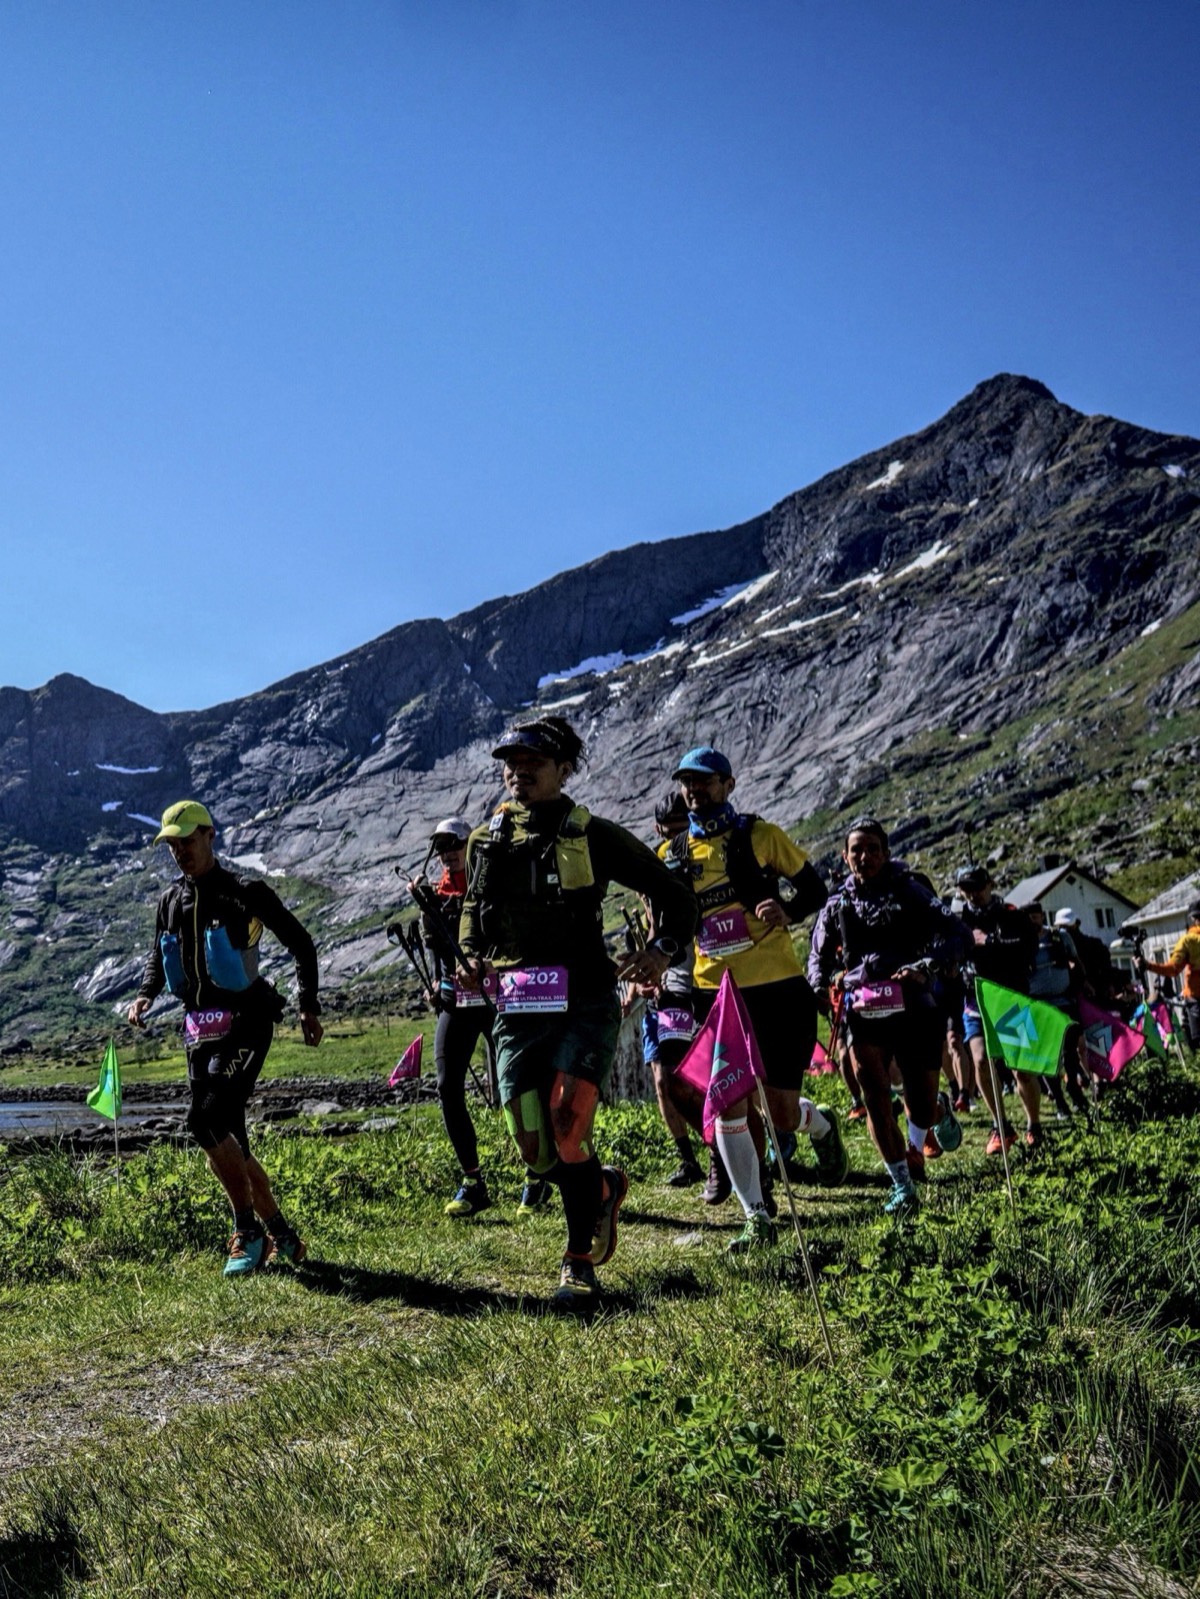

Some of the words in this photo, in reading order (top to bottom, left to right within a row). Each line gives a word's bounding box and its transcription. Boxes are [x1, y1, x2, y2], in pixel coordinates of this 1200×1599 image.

[716, 918, 734, 933] 117
[527, 971, 559, 985] 202
[198, 1011, 224, 1025] 209
[669, 1012, 690, 1022] 179
